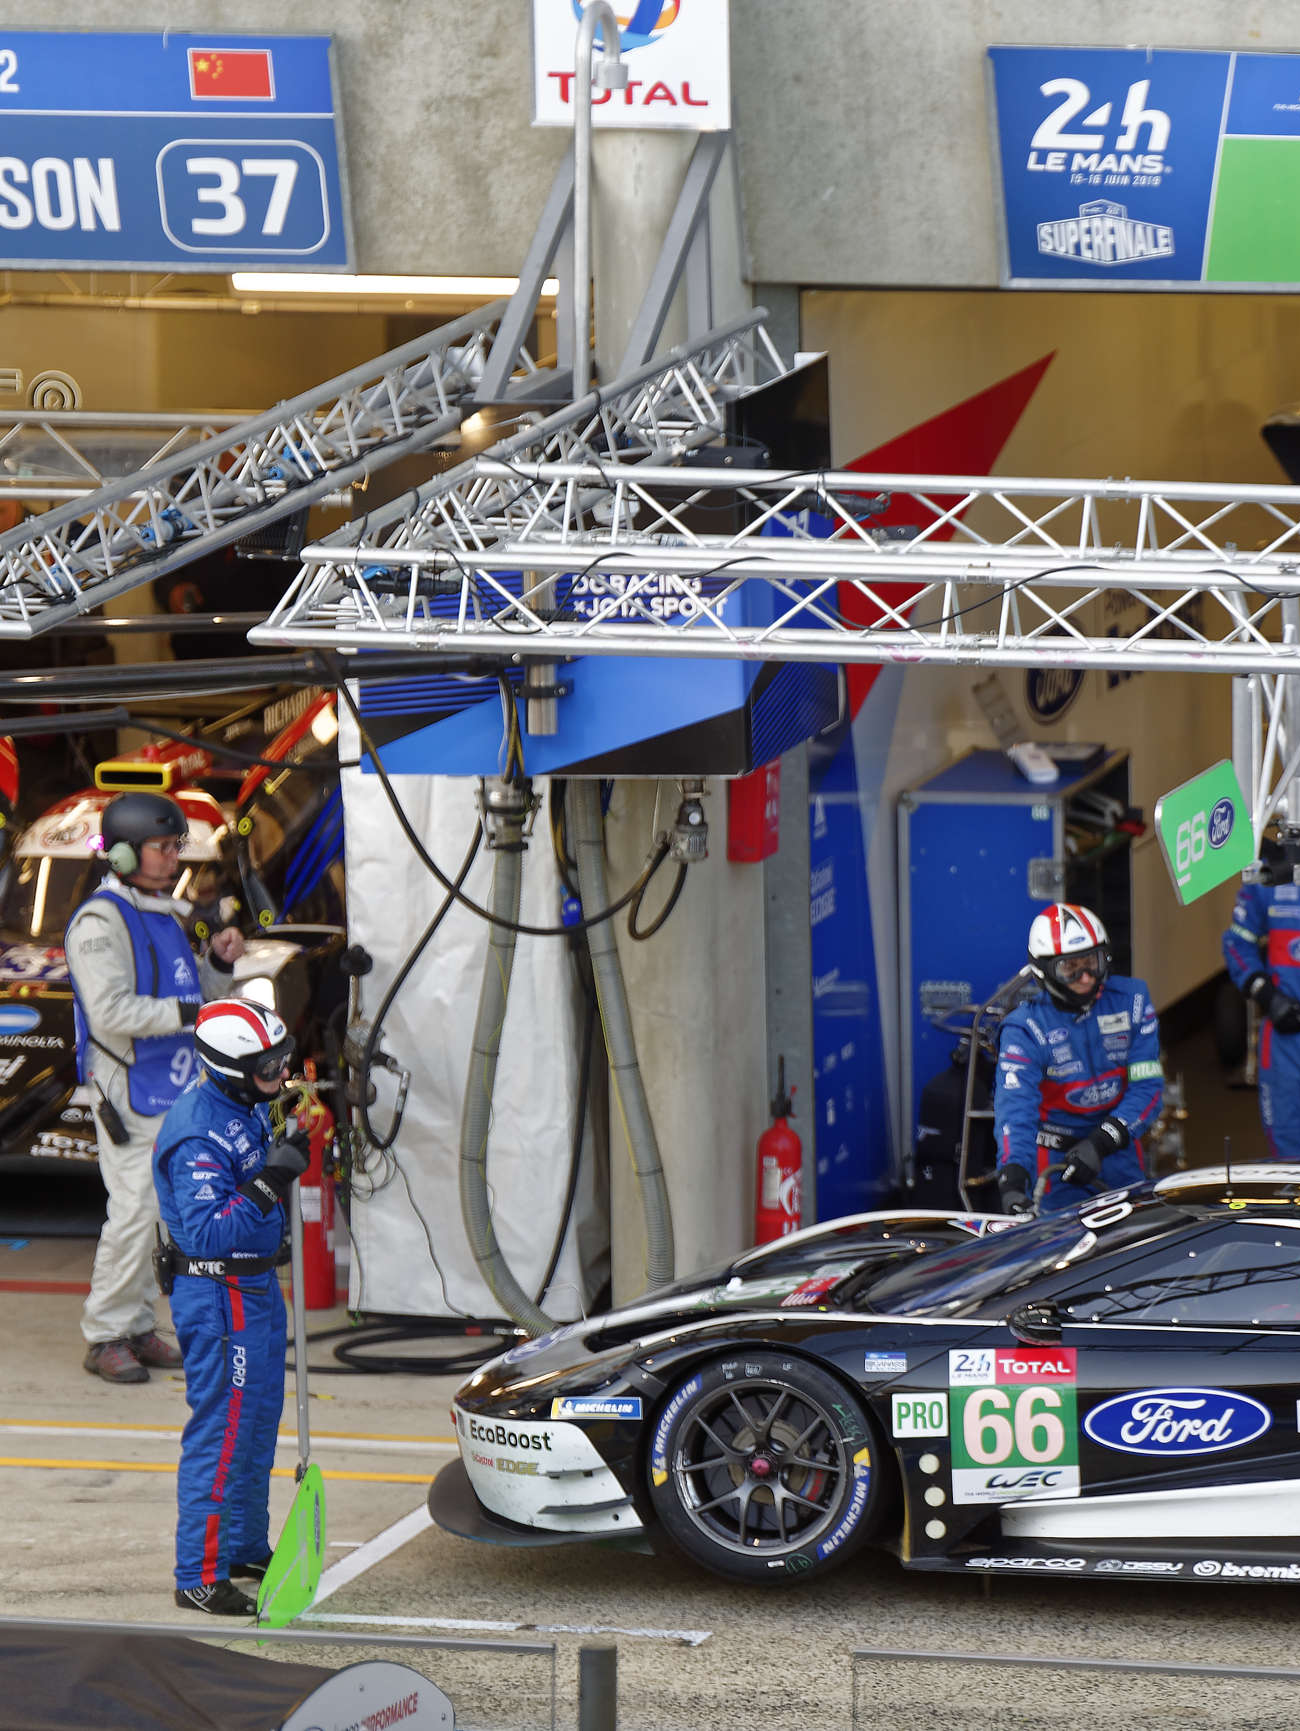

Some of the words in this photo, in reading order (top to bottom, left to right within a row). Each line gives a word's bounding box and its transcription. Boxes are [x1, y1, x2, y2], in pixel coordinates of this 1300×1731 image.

[1031, 77, 1171, 152] 24h
[1027, 151, 1068, 172] LE
[1070, 153, 1164, 174] MANS
[186, 157, 299, 236] 37
[1040, 216, 1172, 263] SUPERFINALE
[608, 574, 703, 596] RACING
[1175, 811, 1206, 873] 66
[1210, 805, 1232, 843] Ford
[232, 1344, 247, 1388] FORD
[998, 1359, 1072, 1375] TOTAL
[574, 1403, 634, 1414] MICHELIN
[654, 1379, 698, 1454] MICHELIN
[896, 1401, 944, 1430] PRO
[962, 1386, 1066, 1466] 66
[1120, 1398, 1236, 1445] Ford
[470, 1418, 553, 1452] EcoBoost
[496, 1456, 541, 1476] EDGE
[986, 1470, 1064, 1490] WEC
[822, 1480, 869, 1554] MICHELIN
[965, 1557, 1087, 1572] sparco
